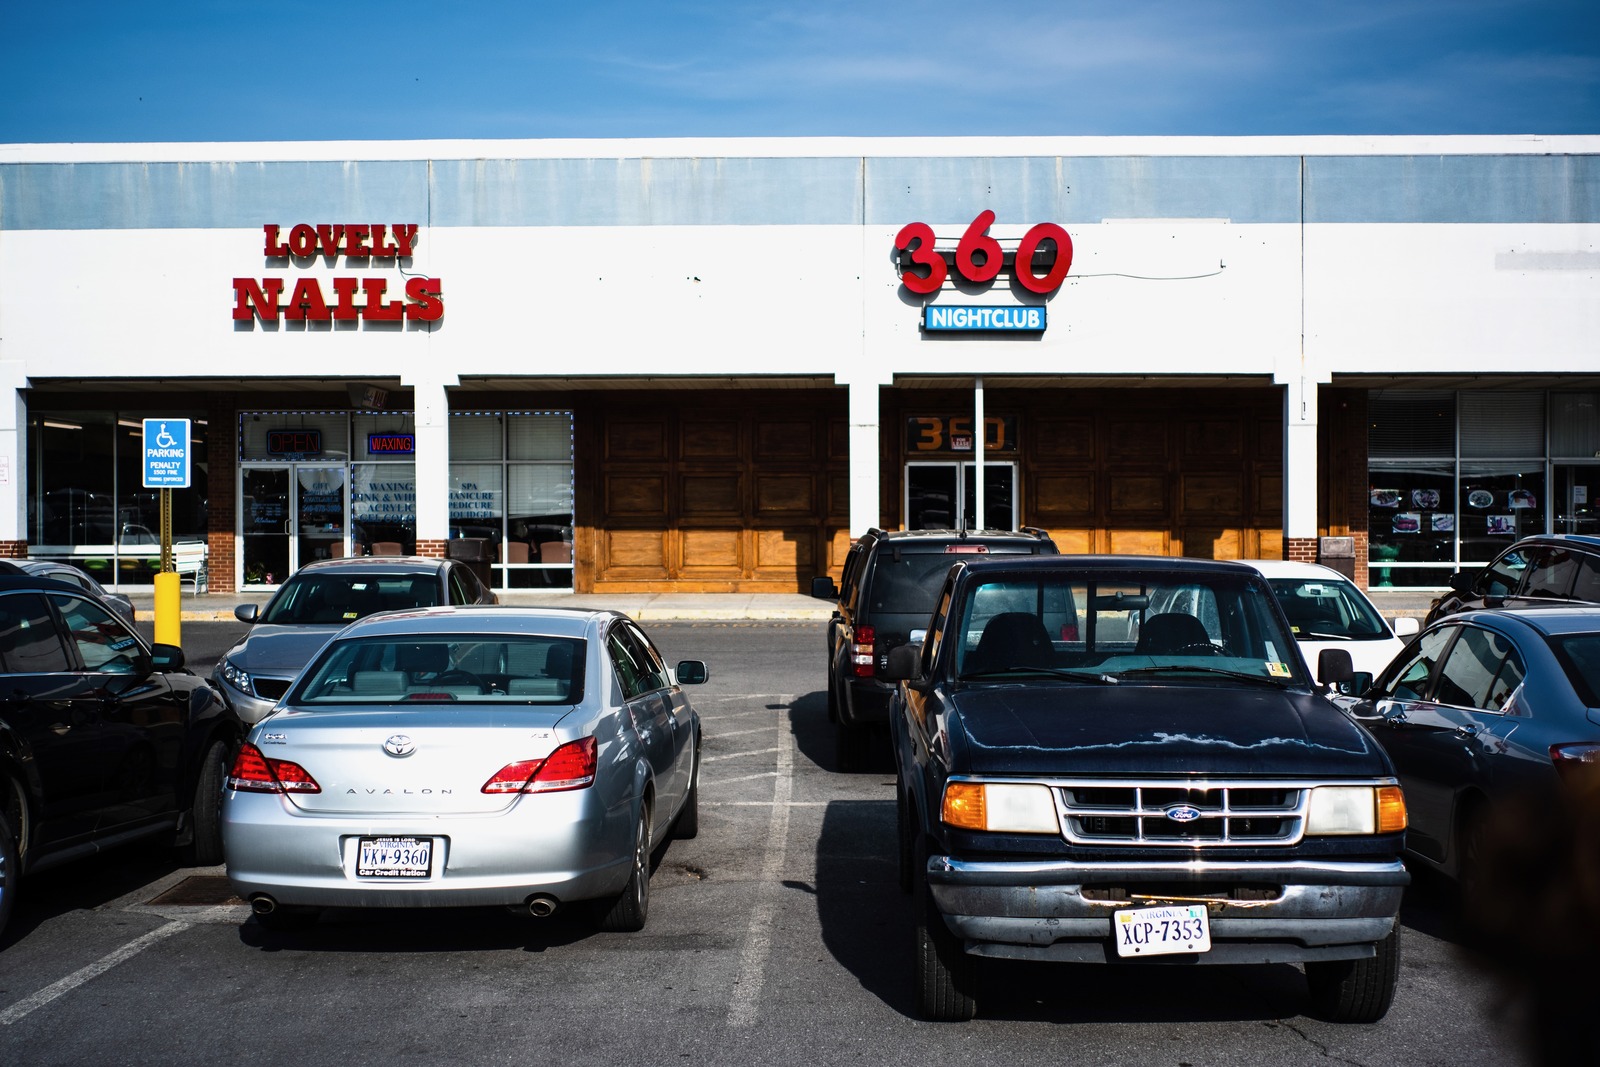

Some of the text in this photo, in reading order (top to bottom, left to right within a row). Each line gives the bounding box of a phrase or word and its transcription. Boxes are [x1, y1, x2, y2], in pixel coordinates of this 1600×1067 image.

[264, 223, 418, 256] LOVELY
[895, 210, 1073, 293] 360
[233, 277, 444, 321] NAILS
[932, 308, 1040, 328] NIGHTCLUB
[270, 433, 318, 452] OPEN
[371, 437, 411, 450] WAXING
[147, 449, 184, 457] PARKING
[369, 482, 413, 491] WAXING
[354, 493, 416, 502] PINK & WHI
[368, 504, 416, 512] ACRYLIC
[384, 514, 415, 523] COLO
[1173, 810, 1193, 818] Ford
[363, 848, 428, 865] VKW-9360
[1140, 910, 1183, 919] VIRGINIA
[1122, 918, 1204, 945] XCP-7353
